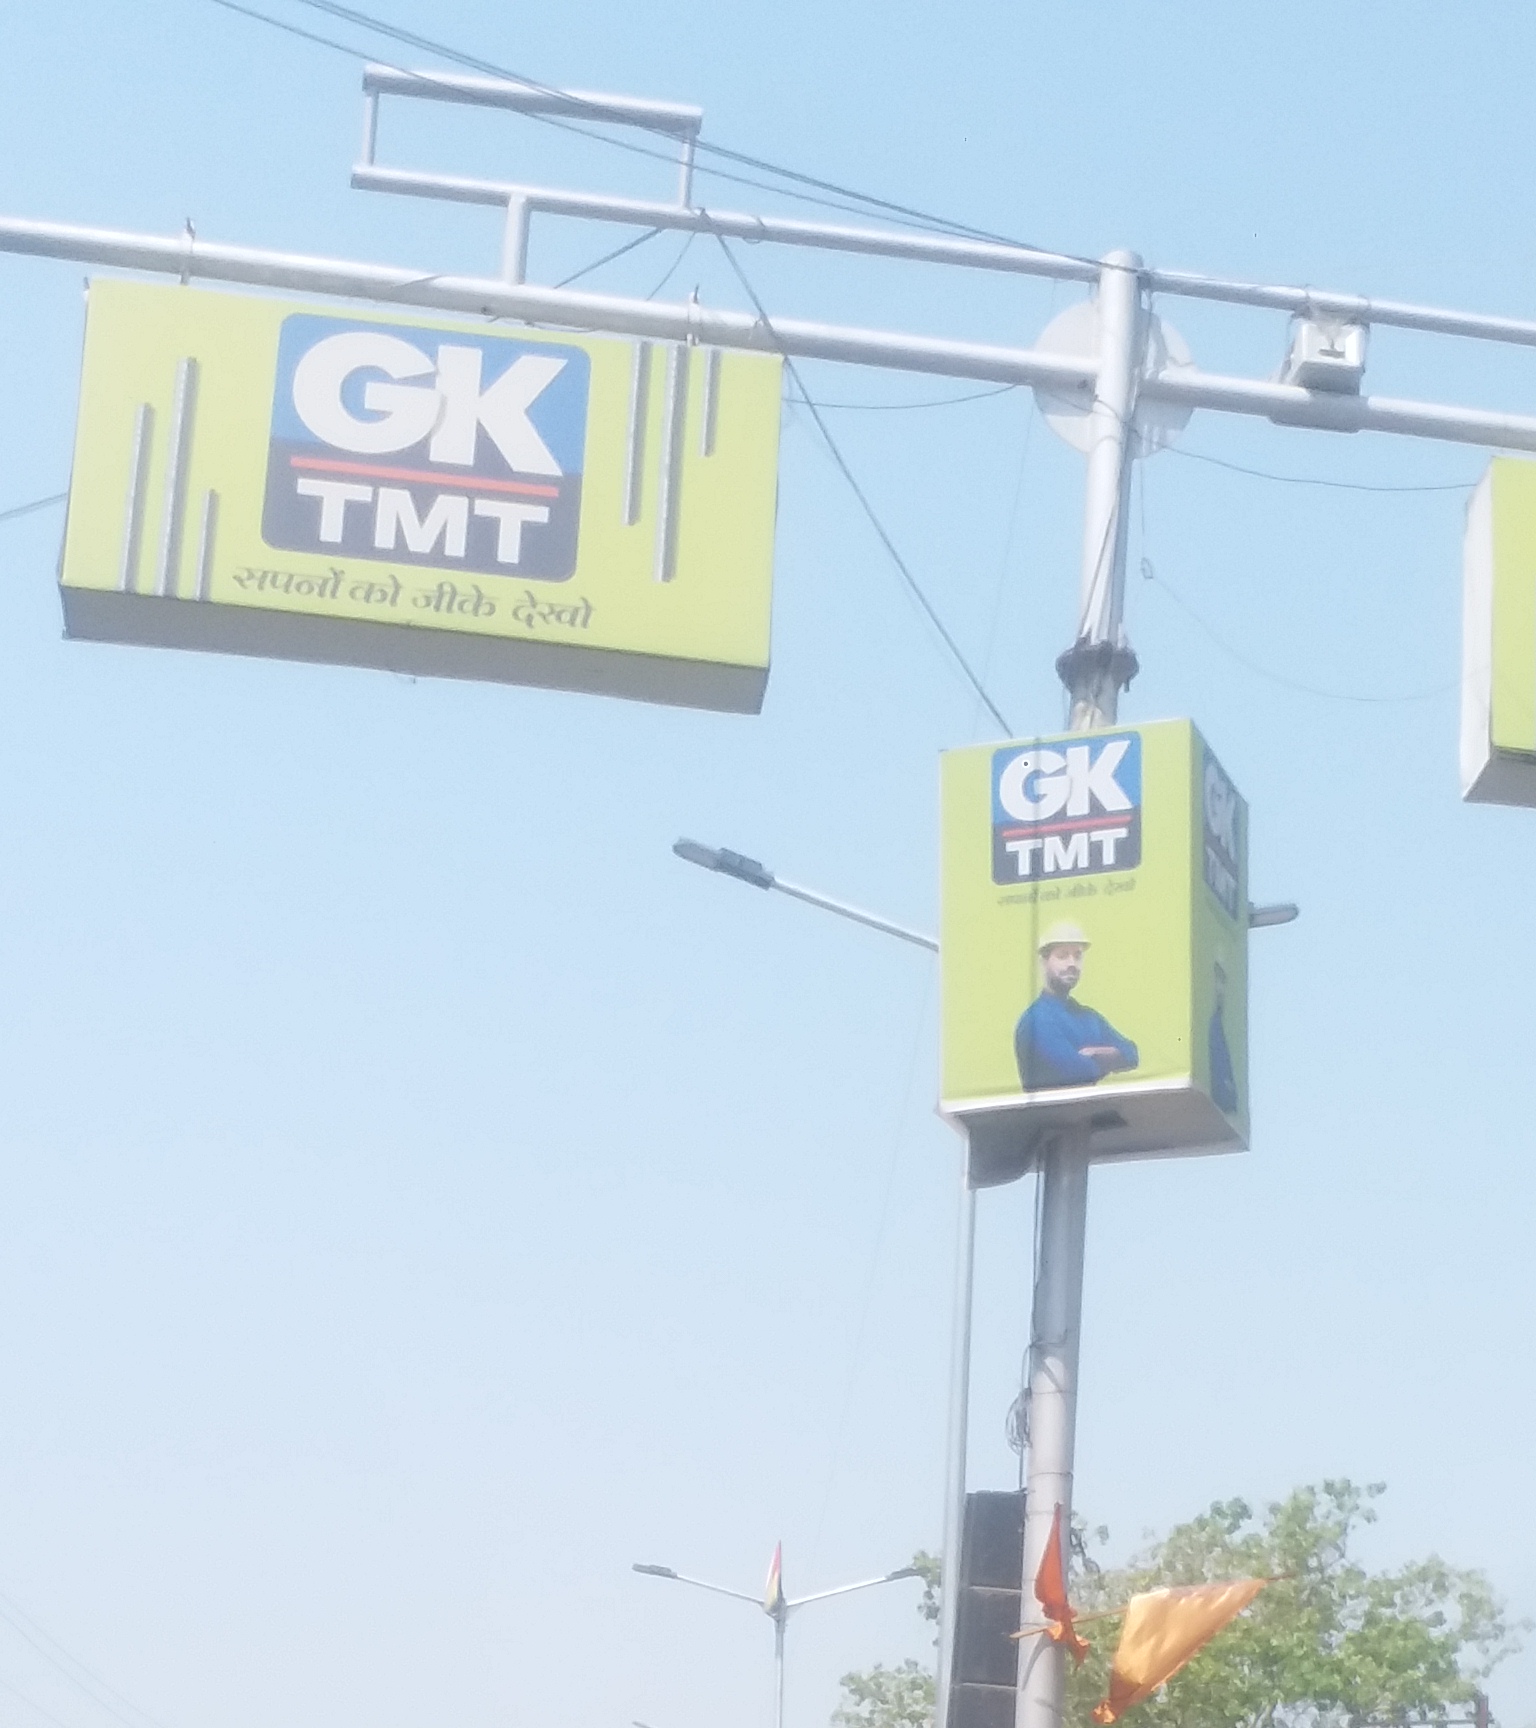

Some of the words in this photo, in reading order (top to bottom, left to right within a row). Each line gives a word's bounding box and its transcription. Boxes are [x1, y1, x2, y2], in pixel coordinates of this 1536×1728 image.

[292, 332, 570, 477] GK
[296, 478, 550, 565] TMT
[233, 566, 343, 603] सपनों
[348, 574, 401, 609] को
[413, 582, 498, 620] जीके
[512, 590, 598, 632] देखो
[999, 740, 1133, 822] GK
[1006, 827, 1129, 876] TMT
